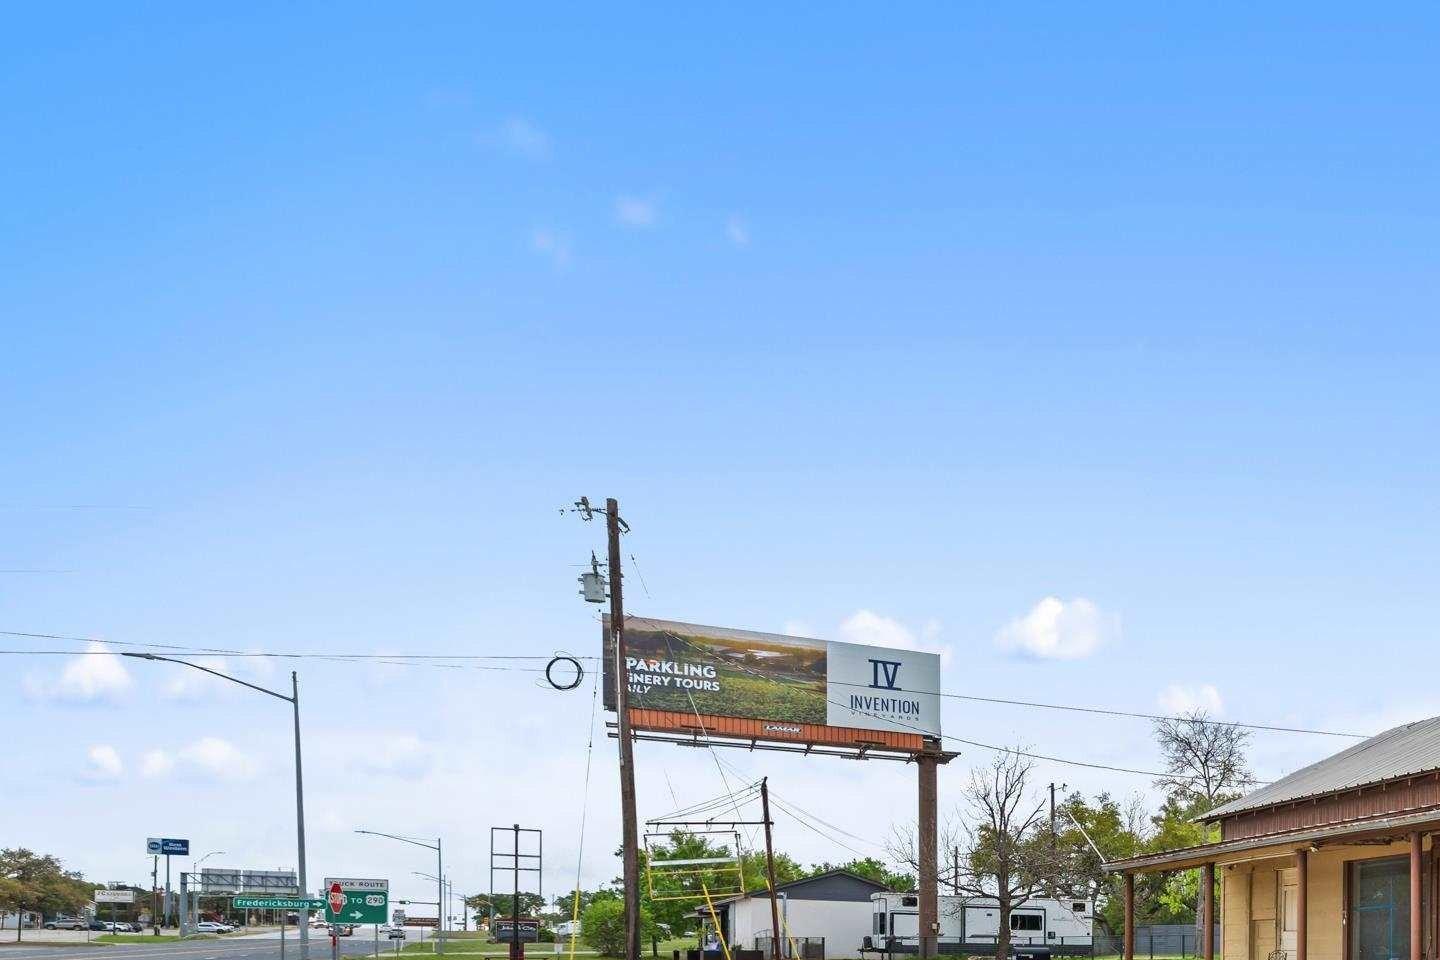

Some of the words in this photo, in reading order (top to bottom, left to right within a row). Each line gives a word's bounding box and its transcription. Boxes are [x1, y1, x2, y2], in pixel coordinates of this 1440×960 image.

[625, 656, 717, 679] PARKLING
[868, 659, 902, 691] IV
[627, 672, 671, 686] INERY
[673, 676, 720, 692] TOURS
[850, 694, 920, 715] INVENTION
[358, 881, 385, 889] ROUTE
[236, 899, 310, 910] Fredericksburg
[367, 896, 384, 905] 290
